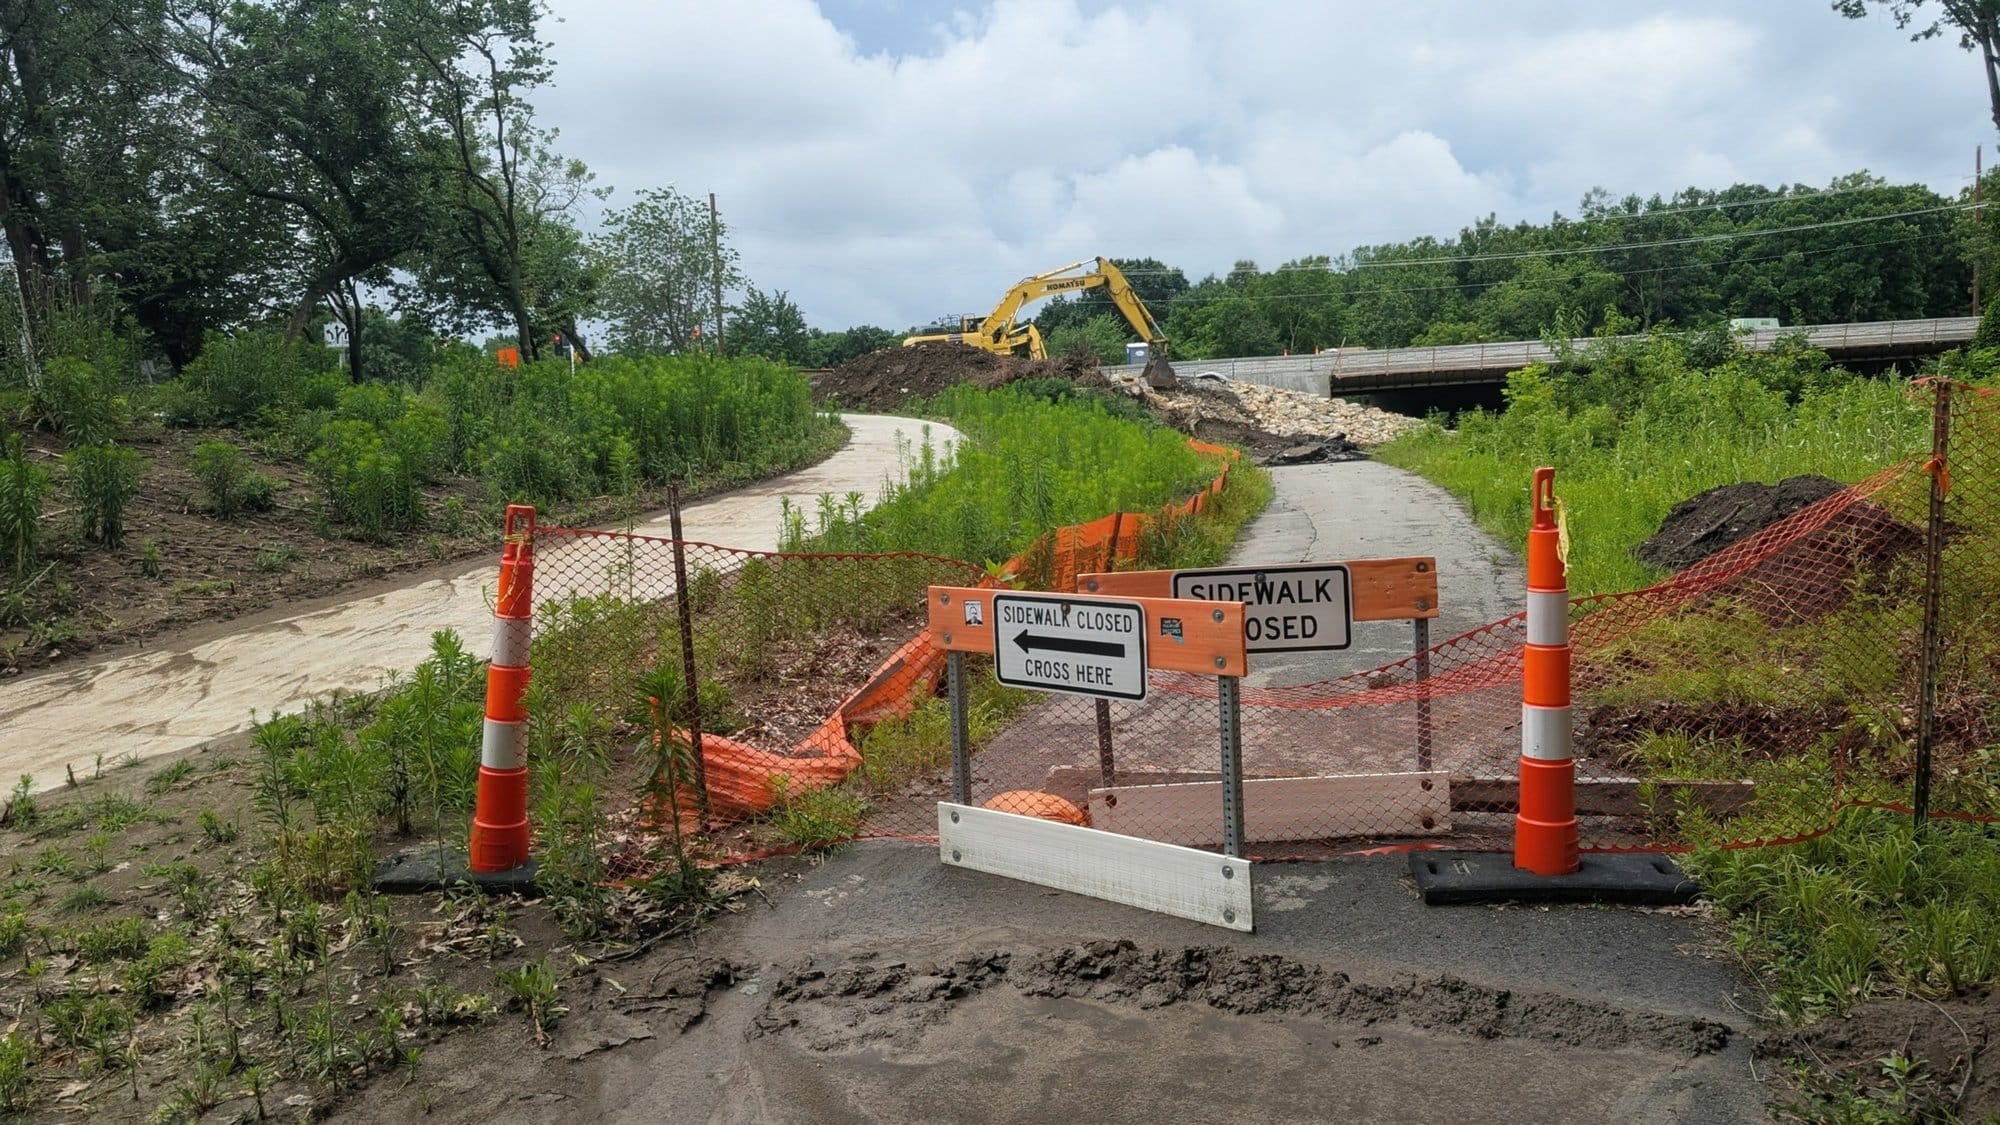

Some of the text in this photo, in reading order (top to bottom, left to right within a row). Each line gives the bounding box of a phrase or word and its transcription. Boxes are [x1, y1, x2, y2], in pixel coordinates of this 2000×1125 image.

[1046, 280, 1085, 291] KOMATSU
[1190, 579, 1332, 606] SIDEWALK
[1004, 605, 1132, 633] SIDEWALK CLOSED
[1245, 615, 1318, 641] OSED
[1025, 659, 1113, 686] CROSS HERE
